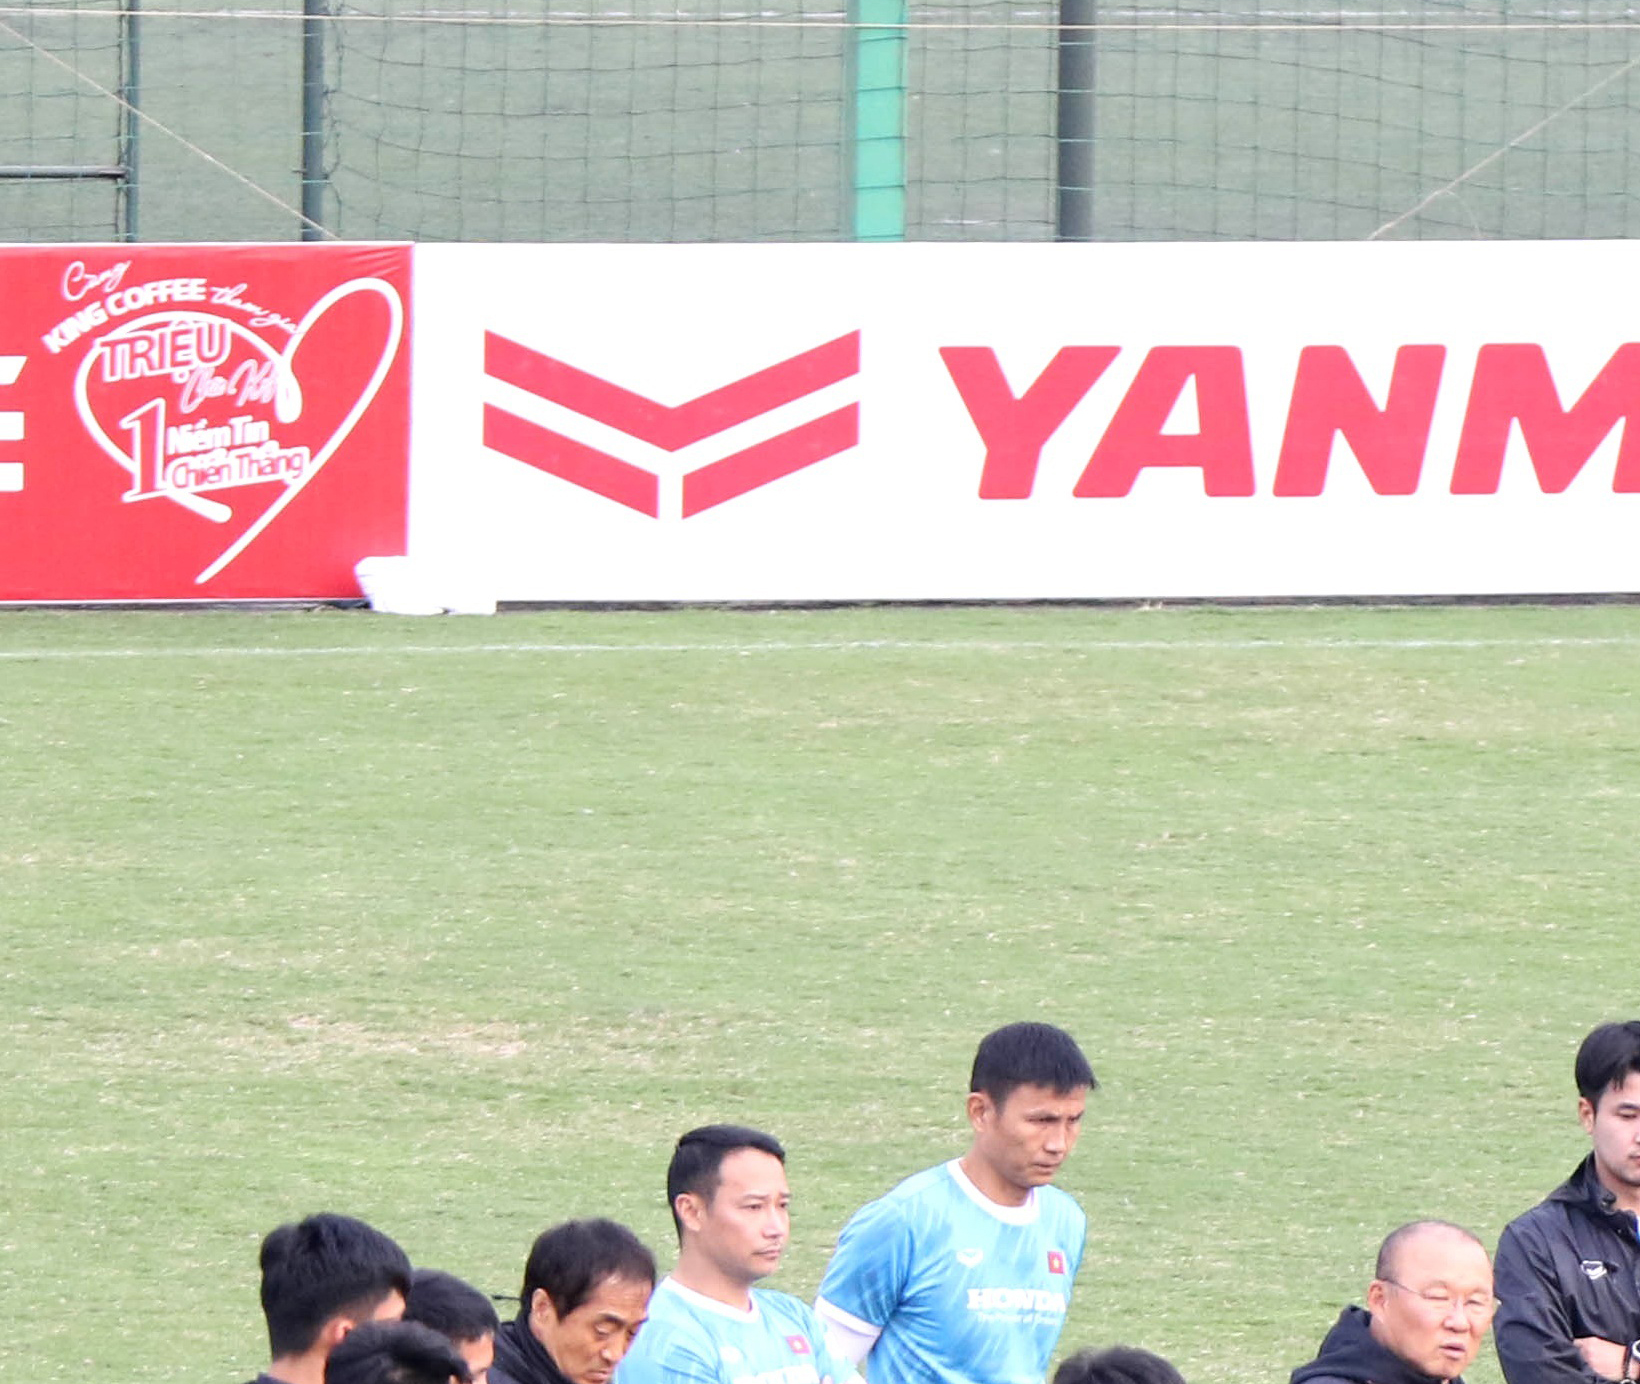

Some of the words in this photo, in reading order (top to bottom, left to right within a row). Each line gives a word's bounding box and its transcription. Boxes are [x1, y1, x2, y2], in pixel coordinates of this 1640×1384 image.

[41, 301, 109, 353] KING
[104, 278, 208, 316] COFFEE
[967, 1287, 1067, 1313] HONDA
